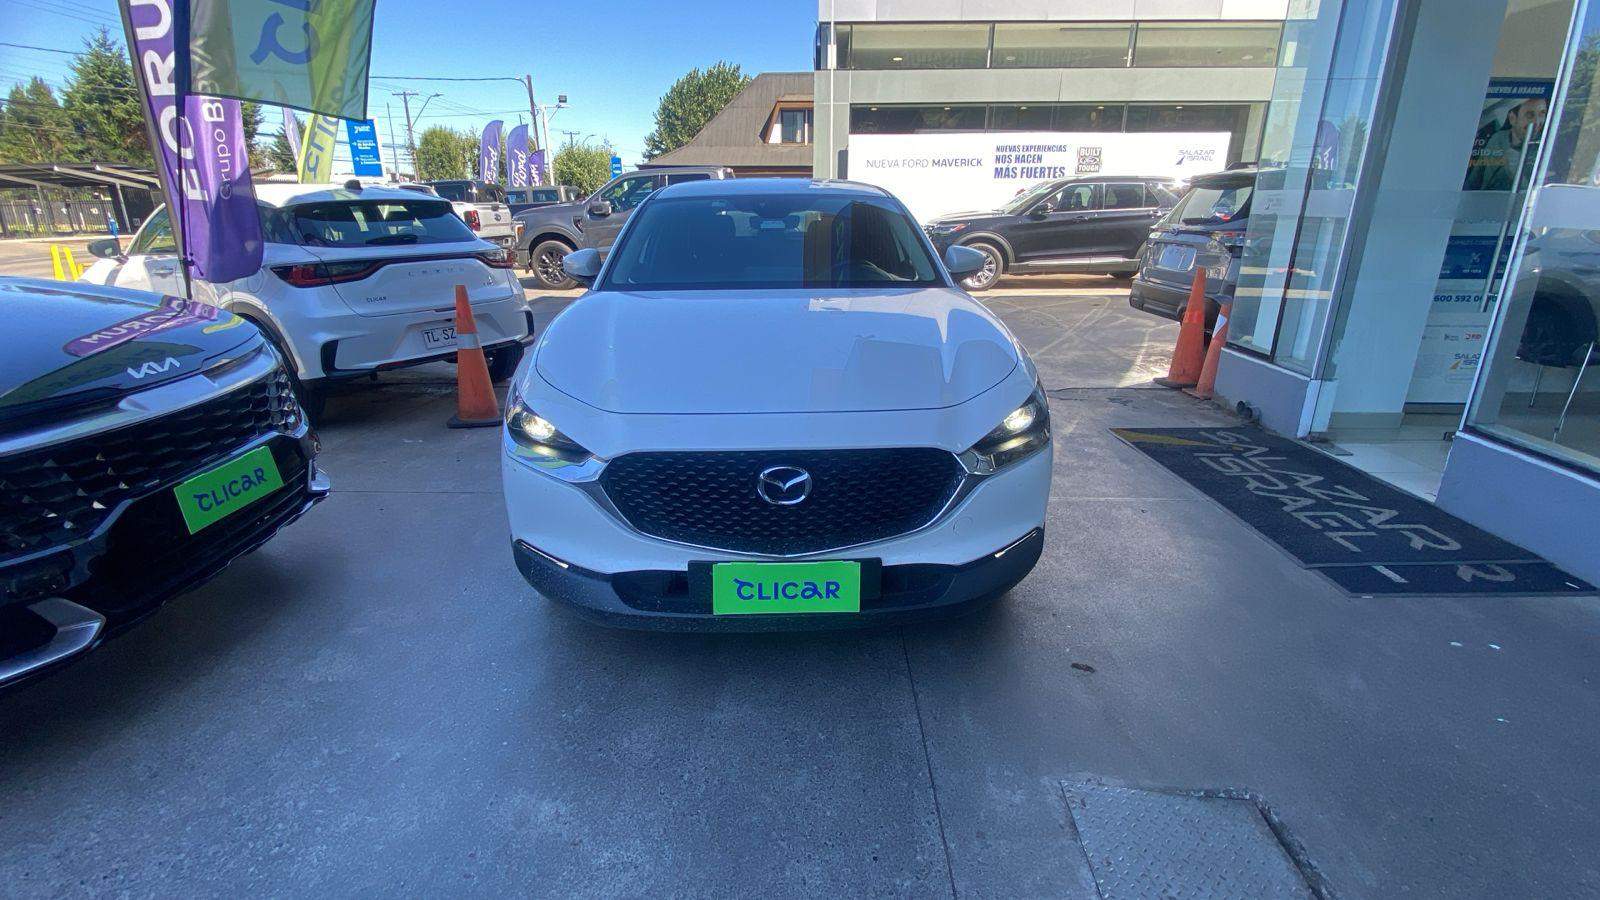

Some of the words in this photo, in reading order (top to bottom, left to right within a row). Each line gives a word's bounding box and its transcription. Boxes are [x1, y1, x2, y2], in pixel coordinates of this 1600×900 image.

[995, 145, 1021, 153] NUEVAS
[1021, 145, 1067, 153] EXPERIENCIAS
[1079, 147, 1102, 157] BUILT
[213, 128, 233, 201] Grupo
[866, 159, 900, 168] NUEVA
[901, 159, 929, 168] FORD
[931, 158, 983, 168] MAVERICK
[995, 154, 1013, 164] NOS
[1014, 154, 1043, 164] HACEN
[511, 149, 527, 188] Ford
[993, 165, 1018, 179] MÁS
[1020, 166, 1066, 179] FUERTES
[1077, 164, 1100, 172] TOUGH
[1455, 294, 1472, 303] 592
[126, 356, 181, 379] KIA
[1199, 430, 1462, 551] SALAZAR
[1194, 453, 1376, 553] ISRAEL
